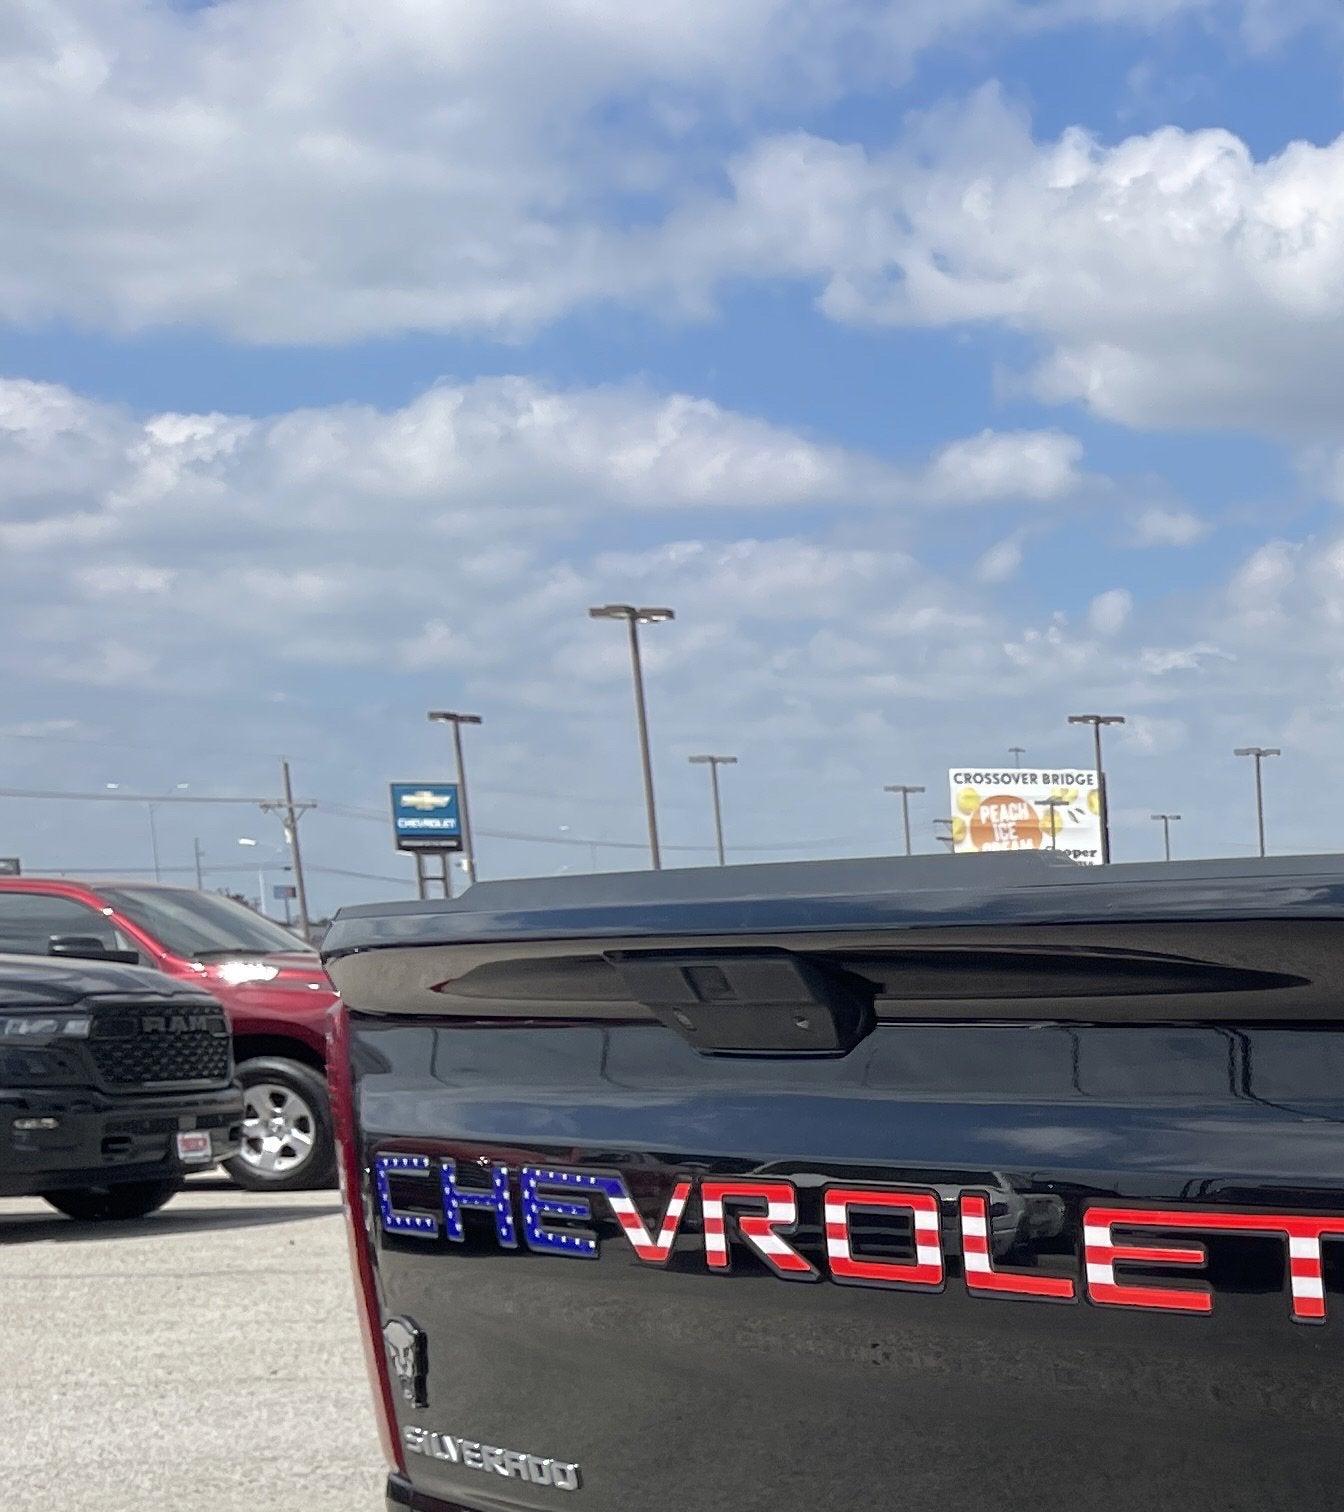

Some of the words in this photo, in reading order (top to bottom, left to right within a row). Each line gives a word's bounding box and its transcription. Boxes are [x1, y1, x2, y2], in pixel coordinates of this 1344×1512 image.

[953, 772, 1039, 785] CROSSOVER
[1042, 773, 1094, 786] BRIDGE
[980, 802, 1030, 824] PEACH
[992, 821, 1018, 842] ICE
[142, 1015, 207, 1035] RAM
[403, 1425, 583, 1491] SILVERADO
